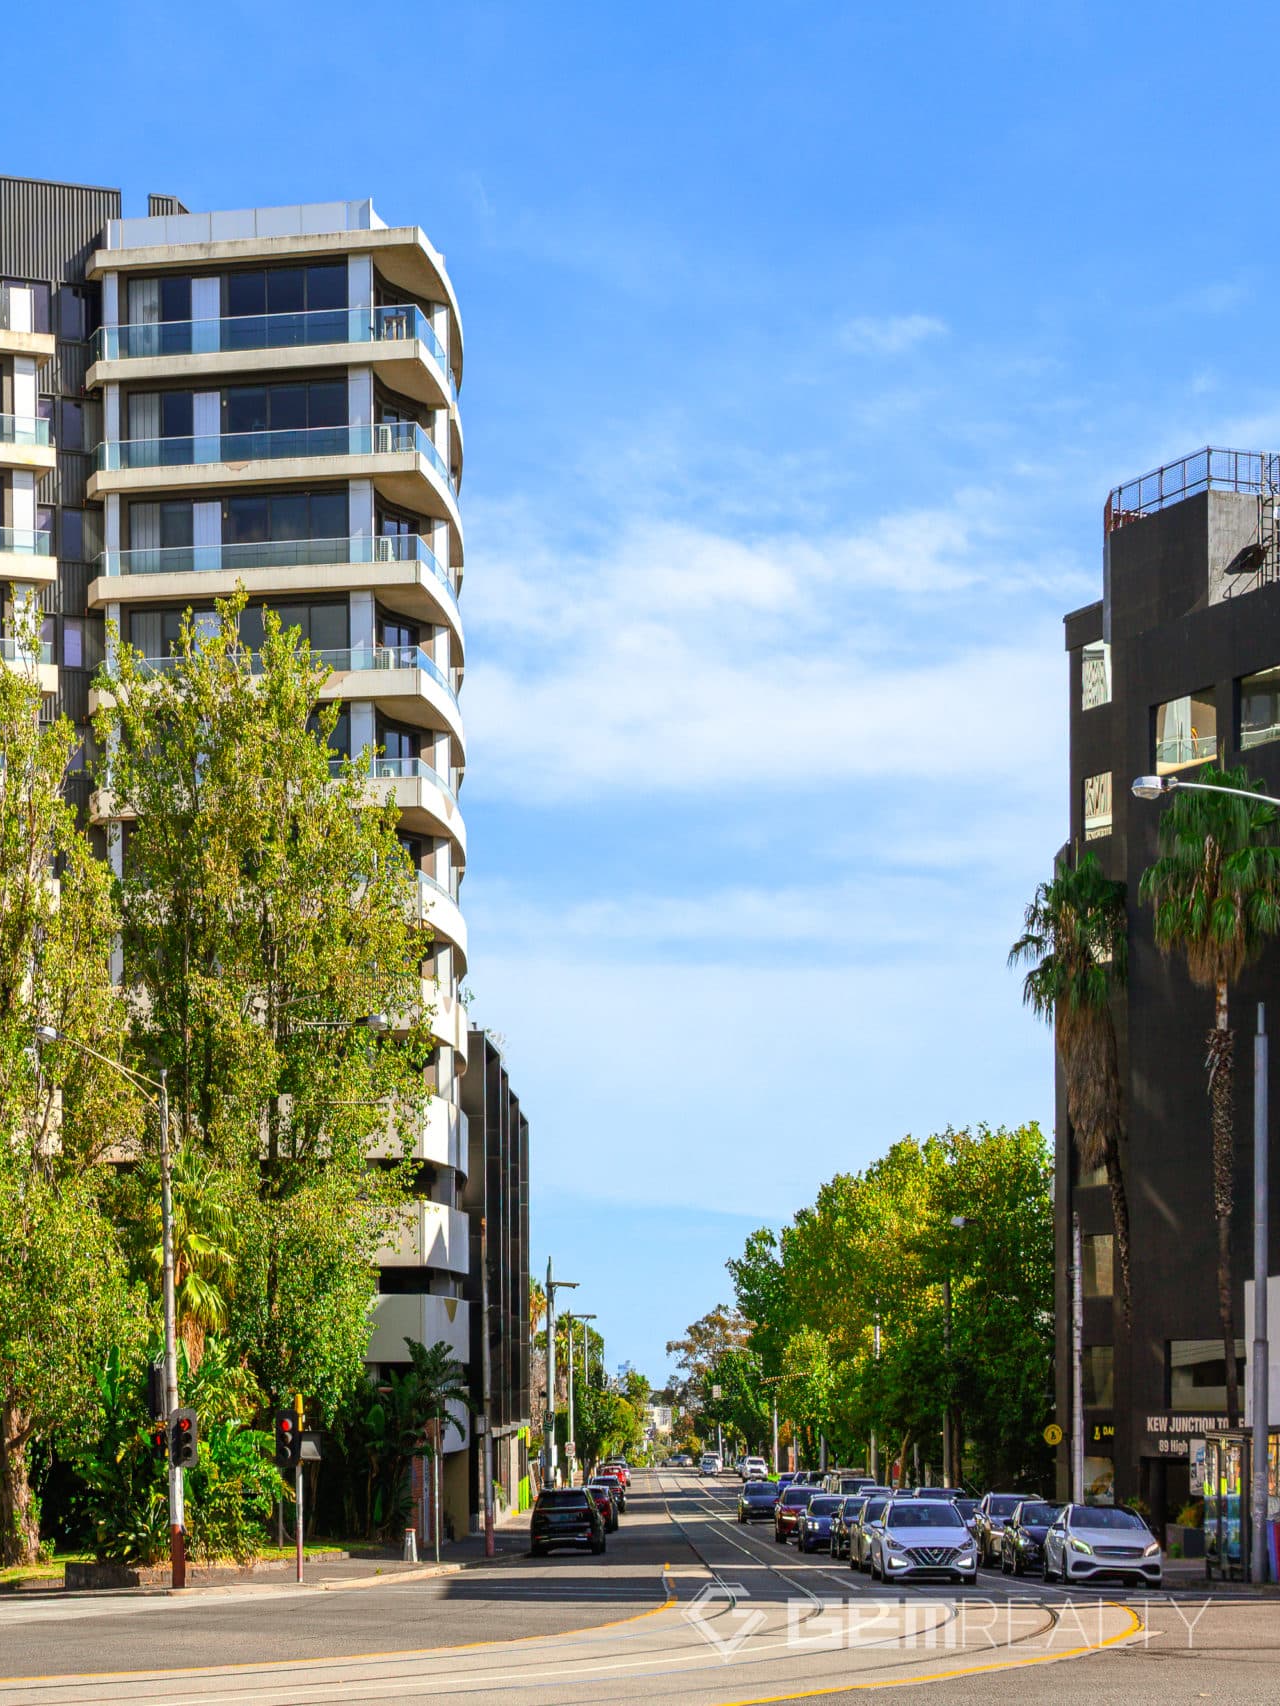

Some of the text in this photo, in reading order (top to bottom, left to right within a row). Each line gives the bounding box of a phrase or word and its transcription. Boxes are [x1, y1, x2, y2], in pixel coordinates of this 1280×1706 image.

[1147, 1416, 1168, 1432] KEW
[1169, 1416, 1215, 1432] JUNCTION
[1159, 1440, 1169, 1452] 89
[1170, 1440, 1188, 1455] High
